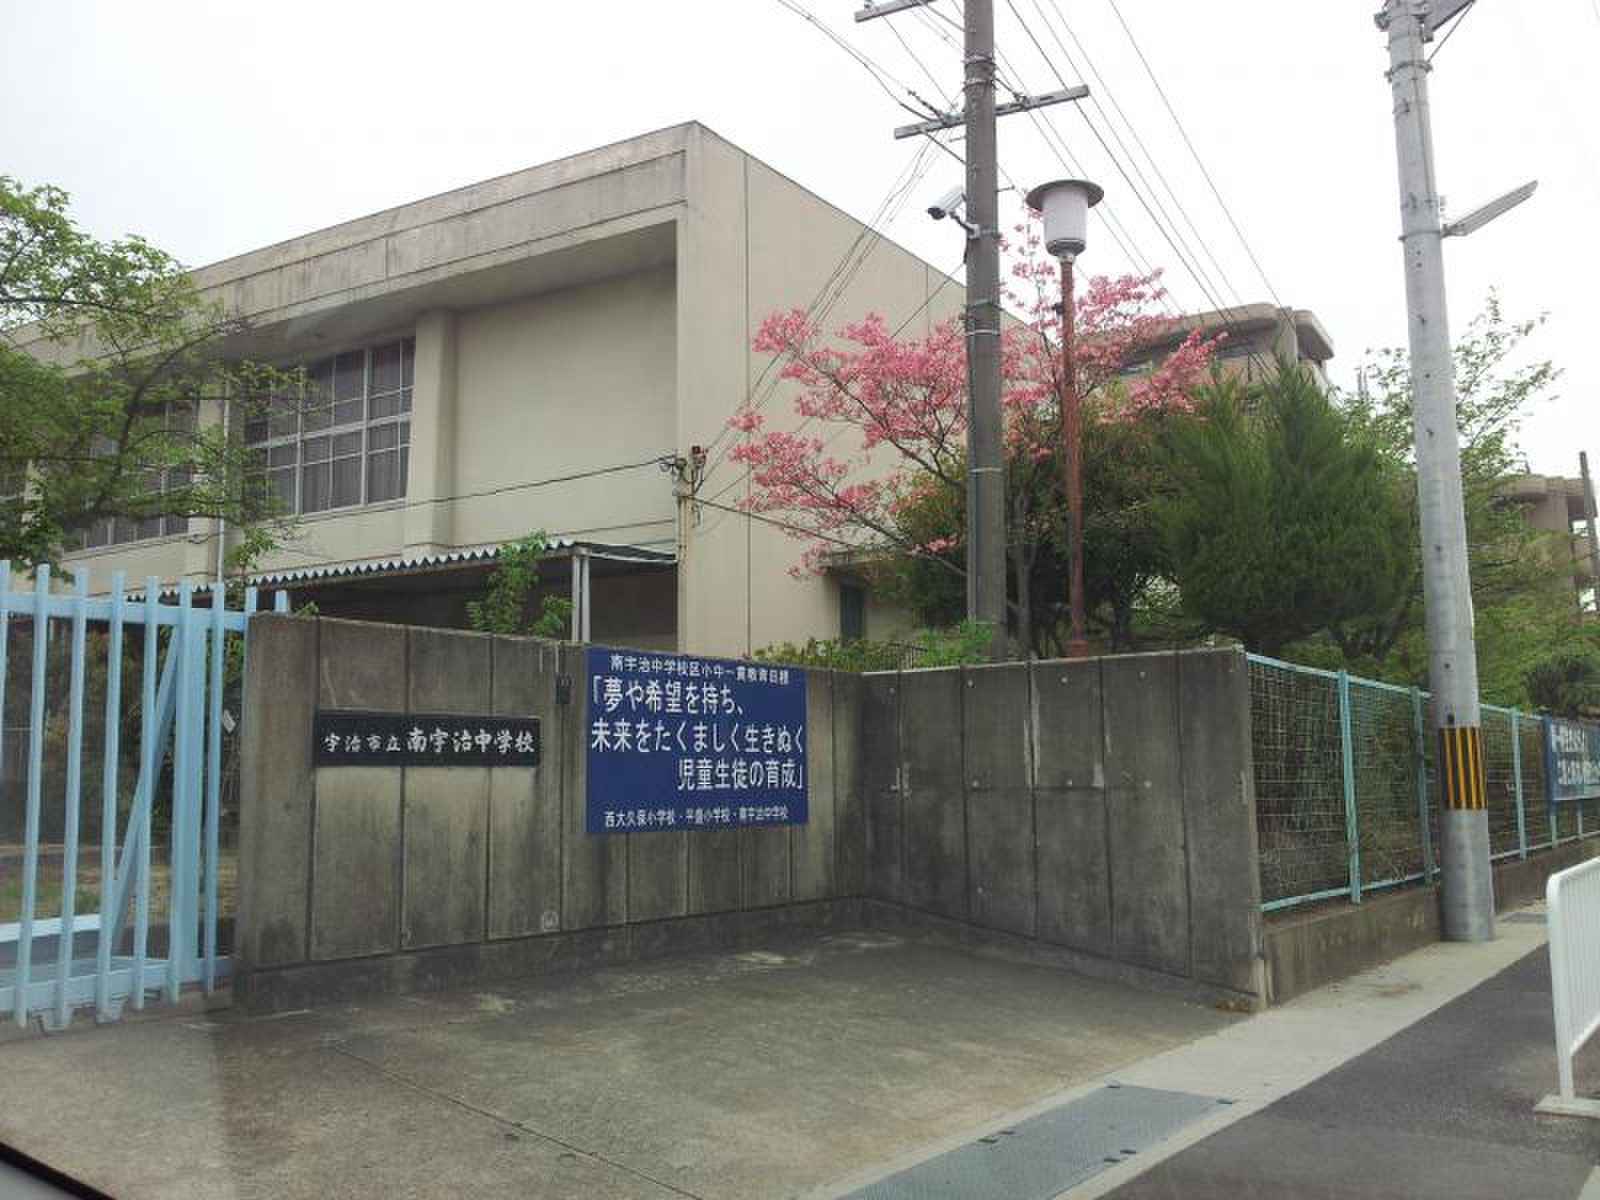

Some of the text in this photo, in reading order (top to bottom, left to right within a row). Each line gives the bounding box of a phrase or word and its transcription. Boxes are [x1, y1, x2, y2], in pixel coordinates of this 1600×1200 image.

[592, 675, 744, 716] 「夢や希望を持ち、
[591, 717, 803, 754] 未来をたくましく生きぬく
[677, 758, 804, 791] 児童生徒の育成」
